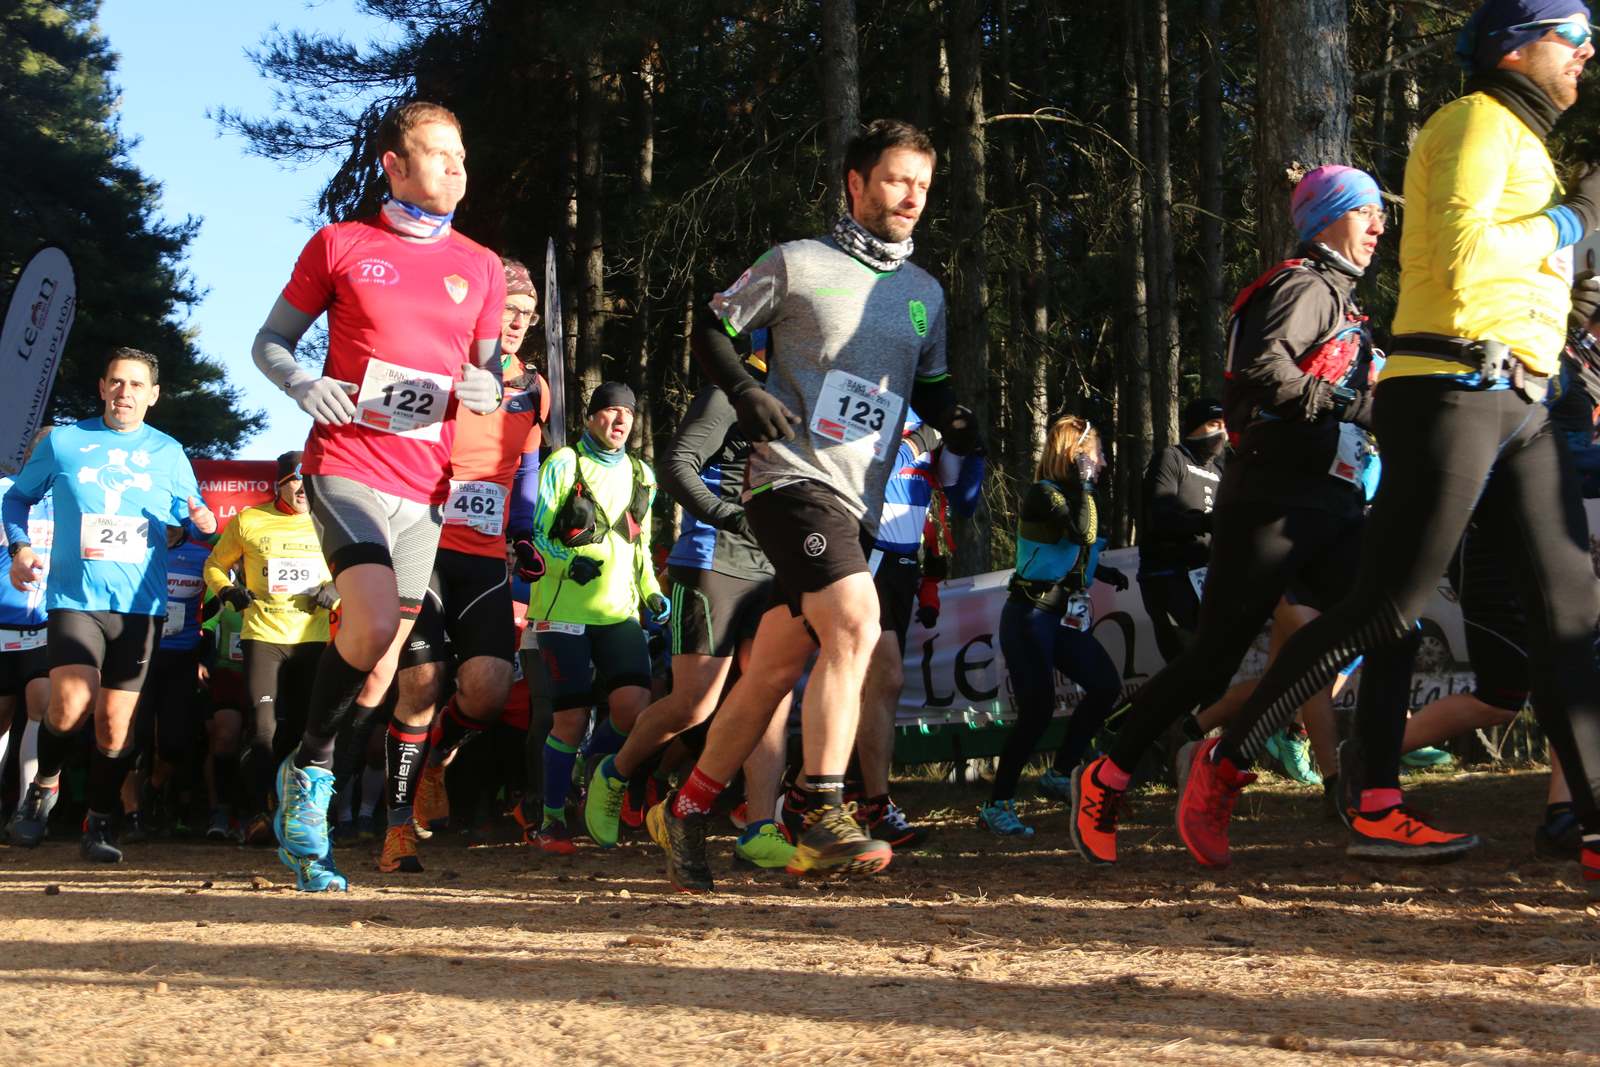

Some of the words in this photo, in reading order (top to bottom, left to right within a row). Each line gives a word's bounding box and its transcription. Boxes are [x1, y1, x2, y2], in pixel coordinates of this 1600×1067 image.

[361, 264, 385, 277] 70
[382, 385, 434, 415] 122
[839, 395, 885, 431] 123
[219, 506, 237, 517] LA
[454, 495, 496, 516] 462
[100, 528, 128, 545] 24
[278, 569, 310, 581] 239
